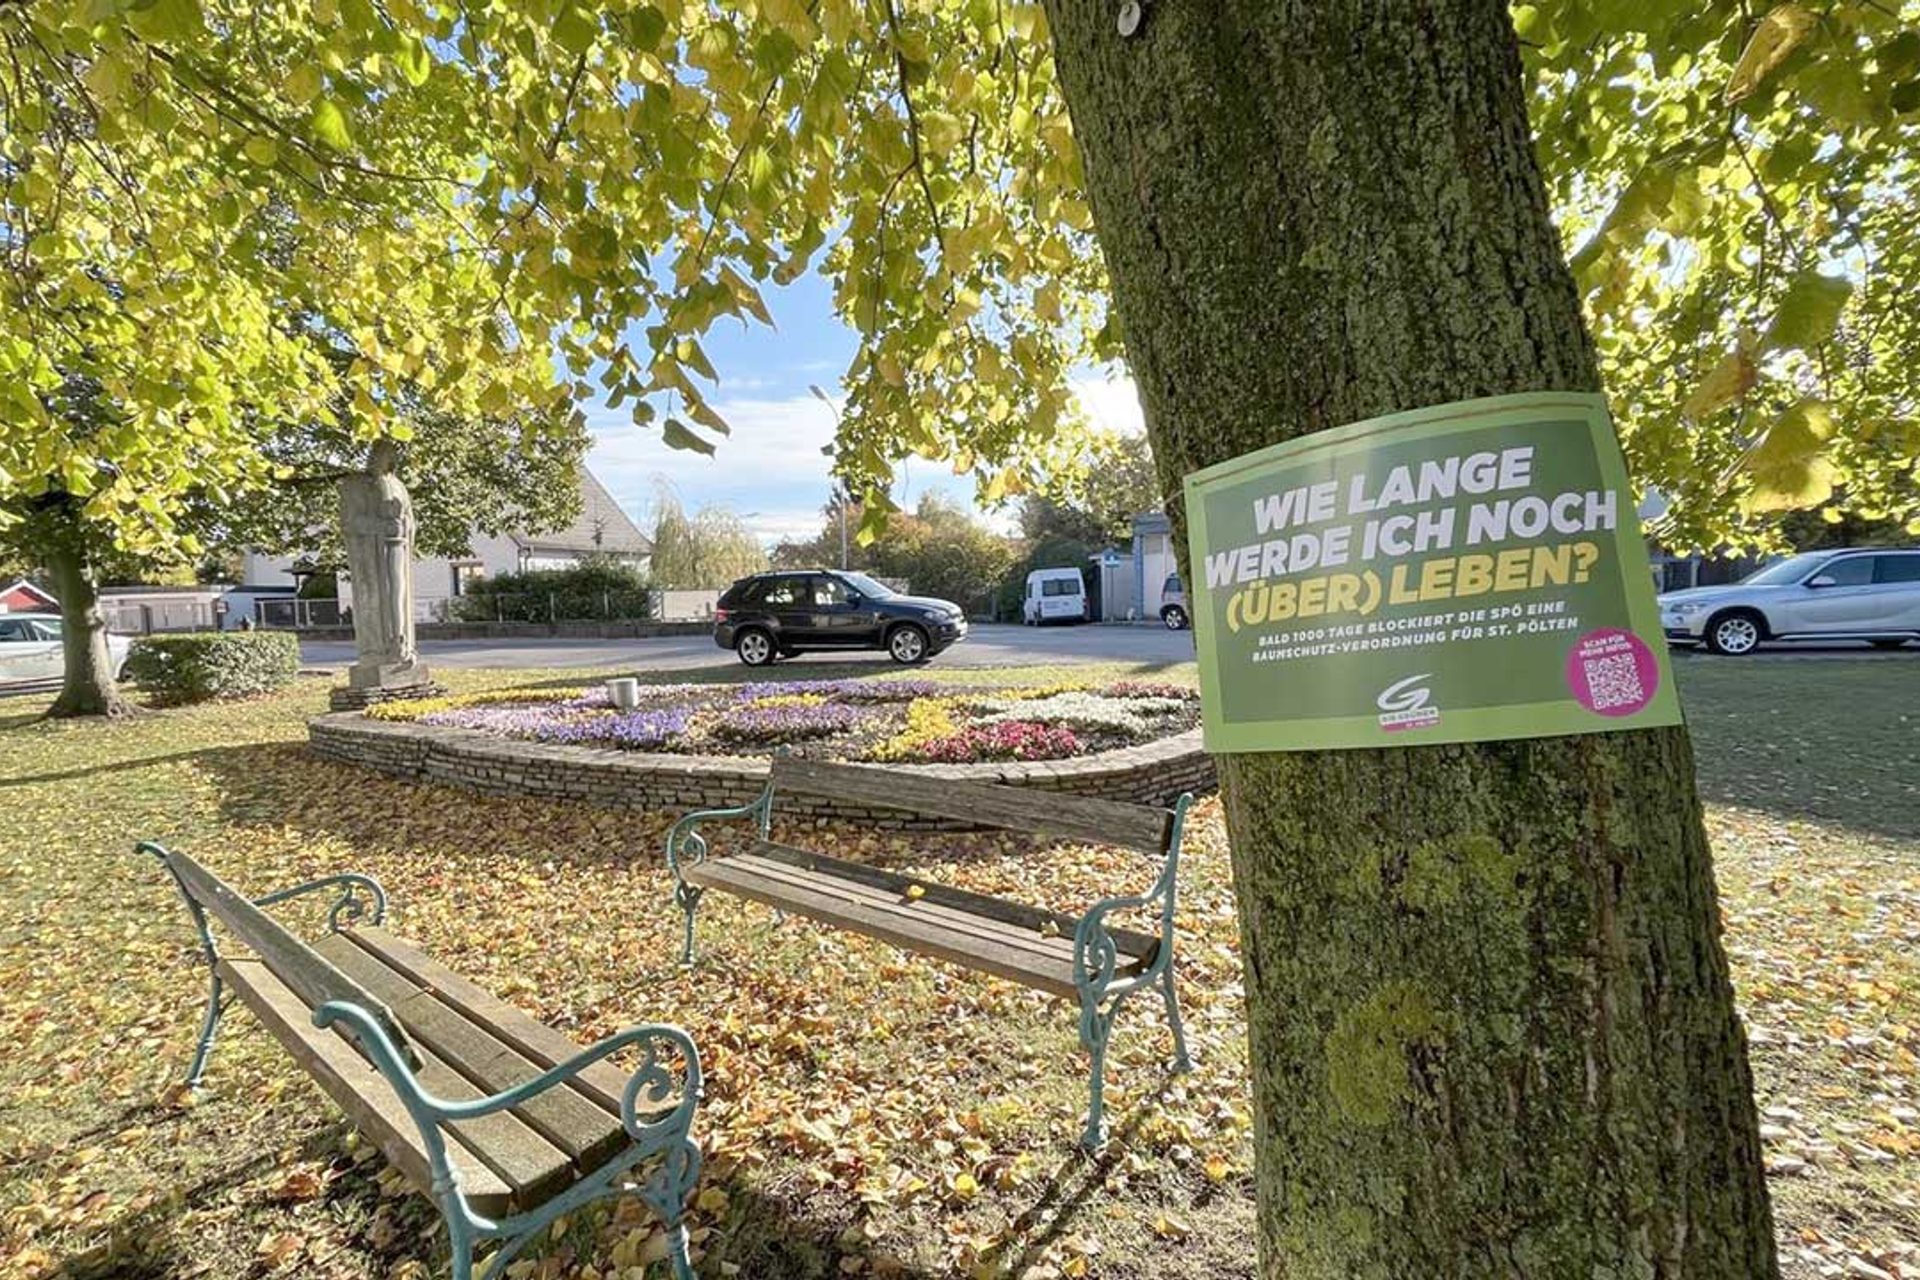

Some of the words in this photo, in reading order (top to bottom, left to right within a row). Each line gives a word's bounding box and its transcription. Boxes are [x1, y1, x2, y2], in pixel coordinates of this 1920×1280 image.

[1254, 481, 1338, 534] WIE
[1348, 447, 1533, 514] LANGE
[1205, 526, 1351, 589] WERDE
[1362, 508, 1455, 560] ICH
[1466, 490, 1616, 545] NOCH
[1227, 569, 1382, 633] (ÜBER)
[1389, 542, 1598, 604] LEBEN?
[1259, 633, 1290, 647] BALD
[1293, 629, 1324, 642] 1000
[1328, 624, 1364, 638] TAGE
[1368, 613, 1455, 633] BLOCKIERT
[1458, 609, 1486, 623] DIE
[1490, 603, 1522, 620] SPÖ
[1527, 601, 1565, 615] EINE
[1451, 626, 1484, 641] FÜR
[1488, 624, 1512, 637] ST.
[1516, 617, 1578, 634] PÖLTEN
